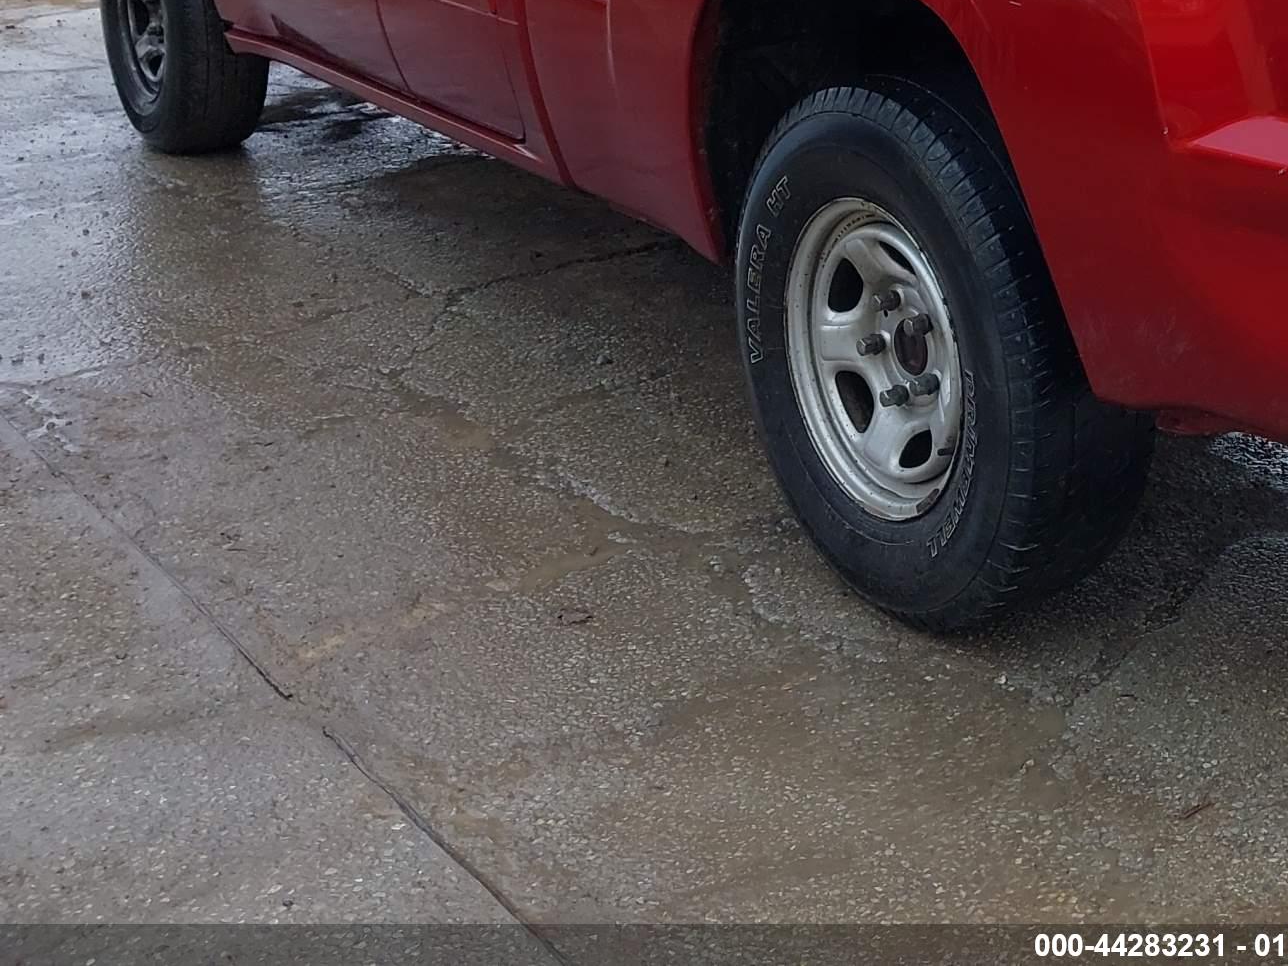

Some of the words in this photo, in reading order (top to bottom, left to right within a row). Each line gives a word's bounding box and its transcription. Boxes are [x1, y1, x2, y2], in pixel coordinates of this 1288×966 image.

[746, 223, 772, 364] VALERA
[766, 175, 792, 218] HT
[926, 369, 978, 558] PRIMEWELL
